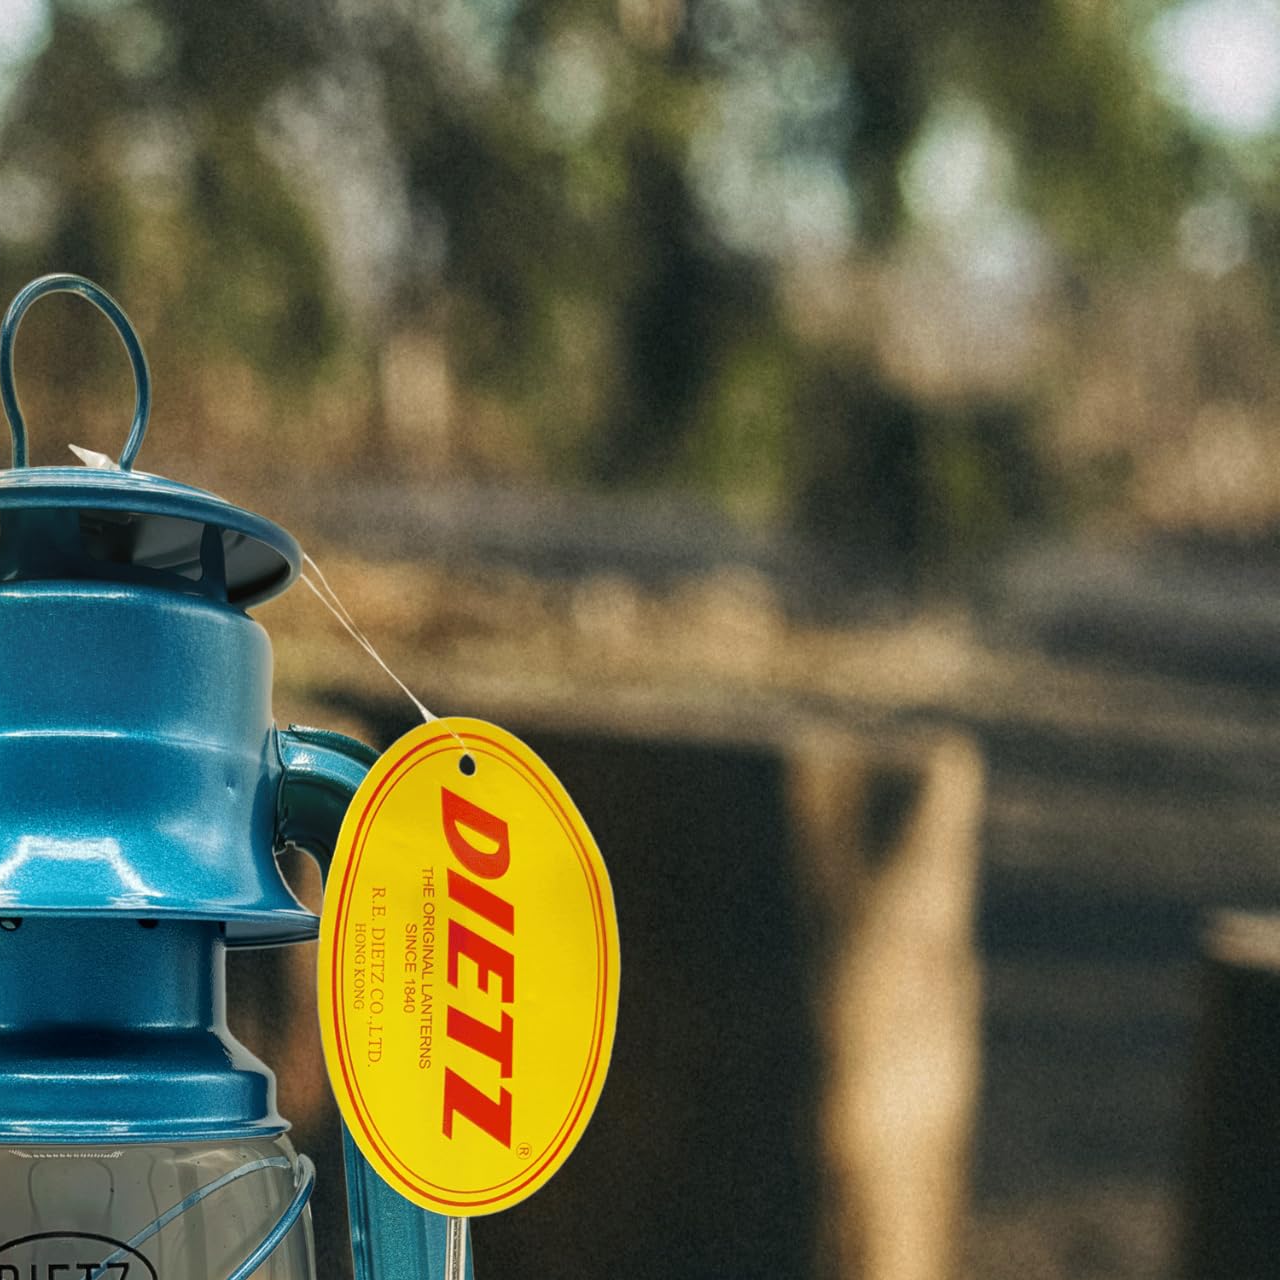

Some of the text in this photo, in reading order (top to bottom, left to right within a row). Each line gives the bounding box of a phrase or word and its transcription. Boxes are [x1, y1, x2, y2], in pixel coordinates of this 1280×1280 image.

[353, 923, 366, 1010] HONG KONG
[370, 928, 385, 983] DIETZ
[403, 923, 417, 1013] SINCE 1840
[419, 866, 435, 1069] THE ORIGINAL LANTERNS
[440, 785, 515, 1149] DIETZ
